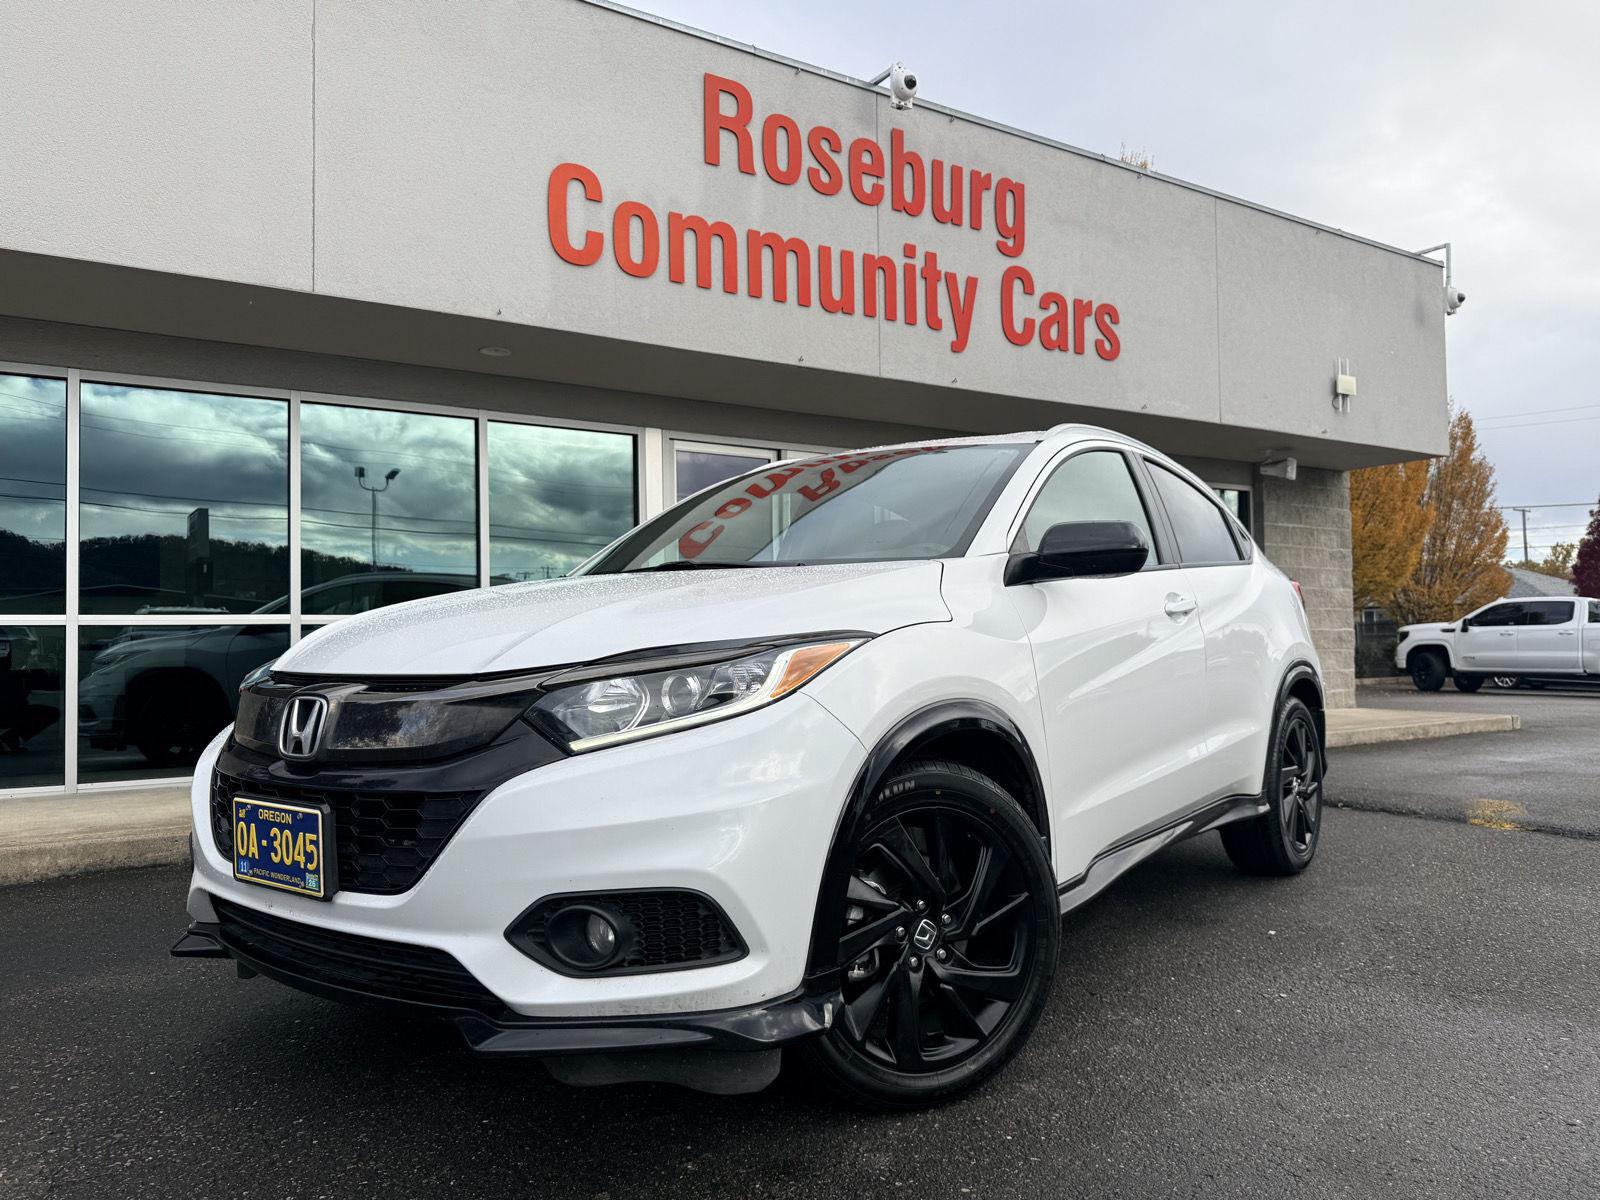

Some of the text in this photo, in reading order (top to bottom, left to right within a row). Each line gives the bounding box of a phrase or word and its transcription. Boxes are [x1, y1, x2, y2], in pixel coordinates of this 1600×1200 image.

[703, 72, 1025, 258] Roseburg
[547, 162, 1121, 361] Community Cars
[258, 808, 292, 825] OREGON
[253, 868, 270, 878] PACIFIC
[270, 872, 301, 885] WONDERLAND
